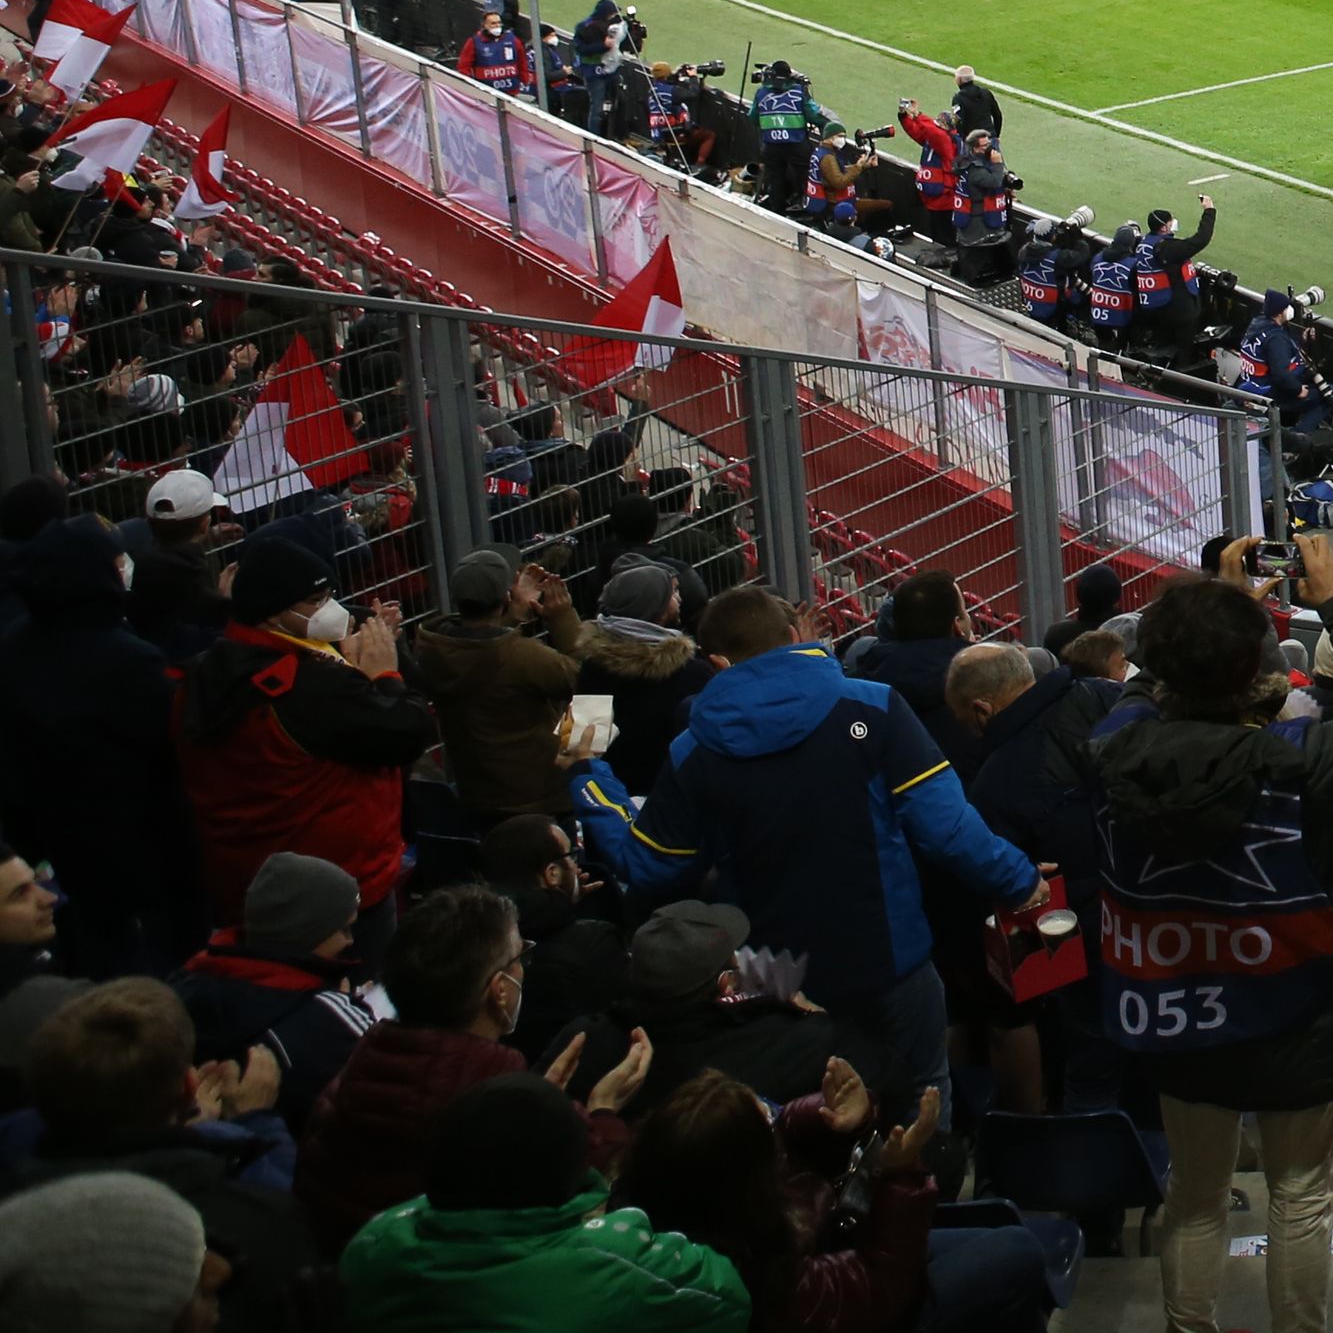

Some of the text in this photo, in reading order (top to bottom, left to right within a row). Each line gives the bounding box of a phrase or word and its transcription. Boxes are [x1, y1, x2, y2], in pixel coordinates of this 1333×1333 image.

[771, 116, 785, 126] TV
[771, 129, 789, 140] 020
[1100, 899, 1273, 967] PHOTO
[1119, 986, 1228, 1037] 053
